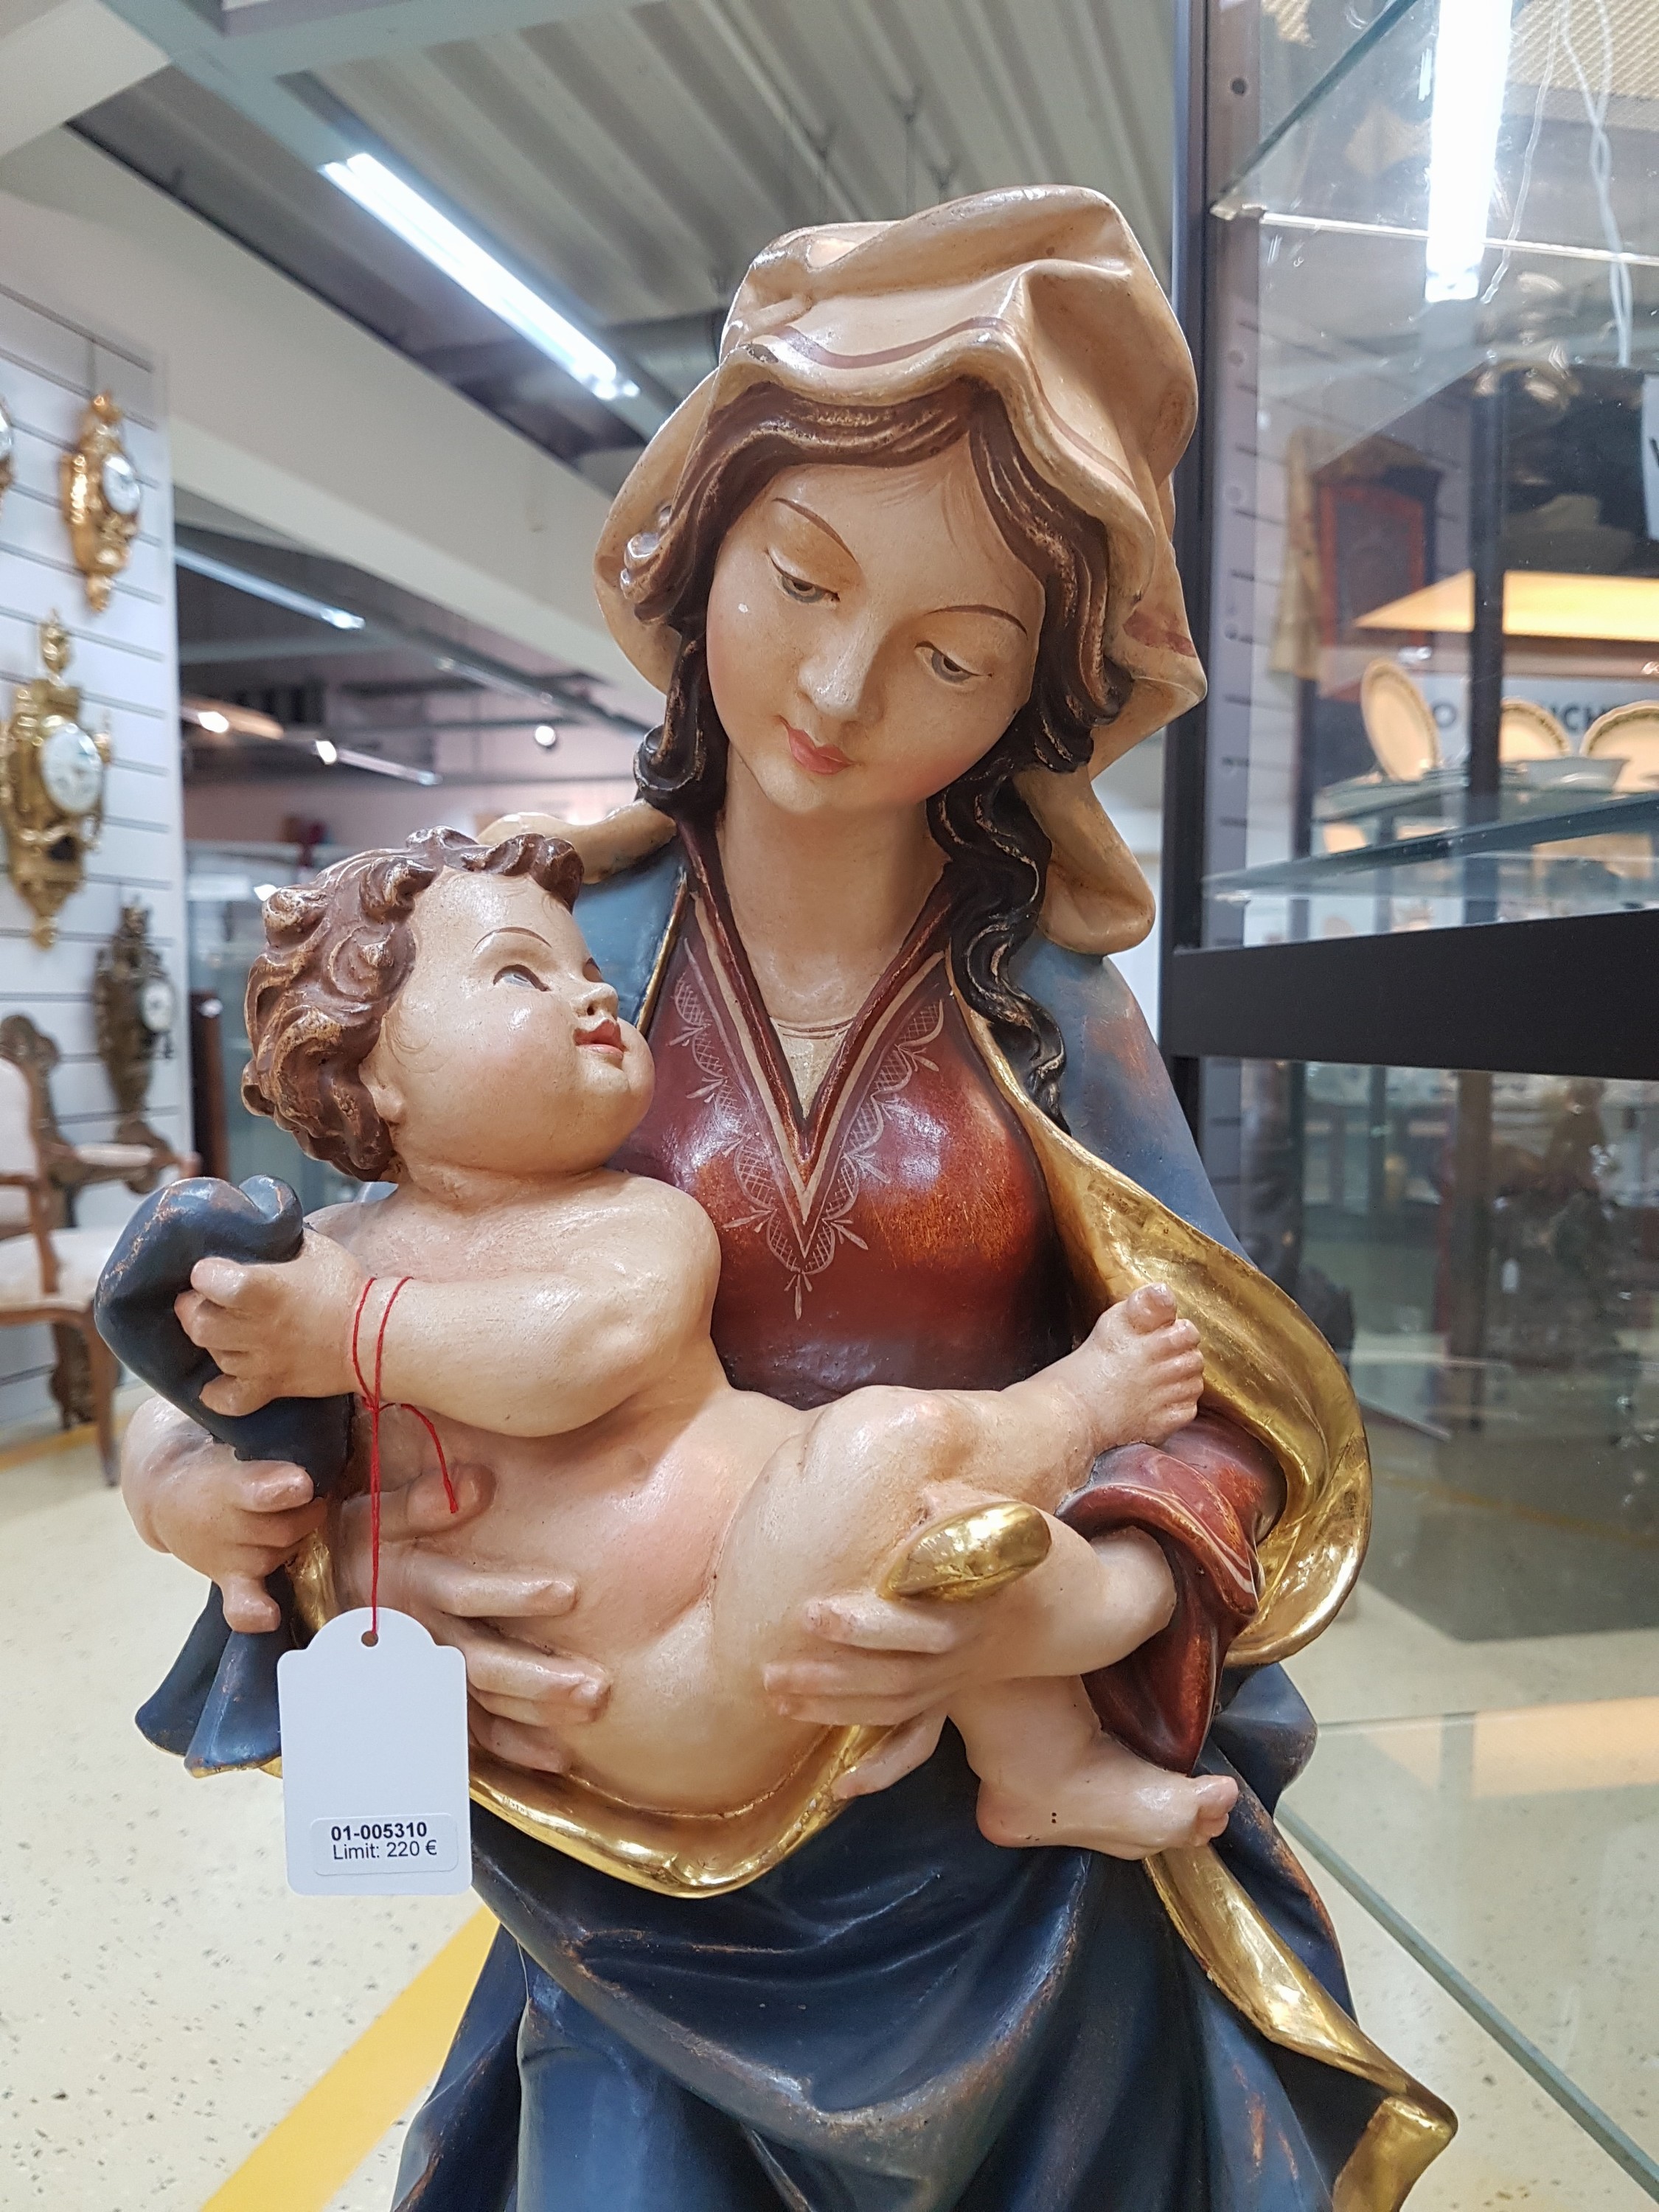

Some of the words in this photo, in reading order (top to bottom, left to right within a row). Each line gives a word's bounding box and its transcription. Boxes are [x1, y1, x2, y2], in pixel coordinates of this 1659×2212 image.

[330, 1821, 428, 1841] 01-005310
[333, 1843, 380, 1860] Limit:
[386, 1840, 420, 1857] 220
[425, 1839, 437, 1856] €
